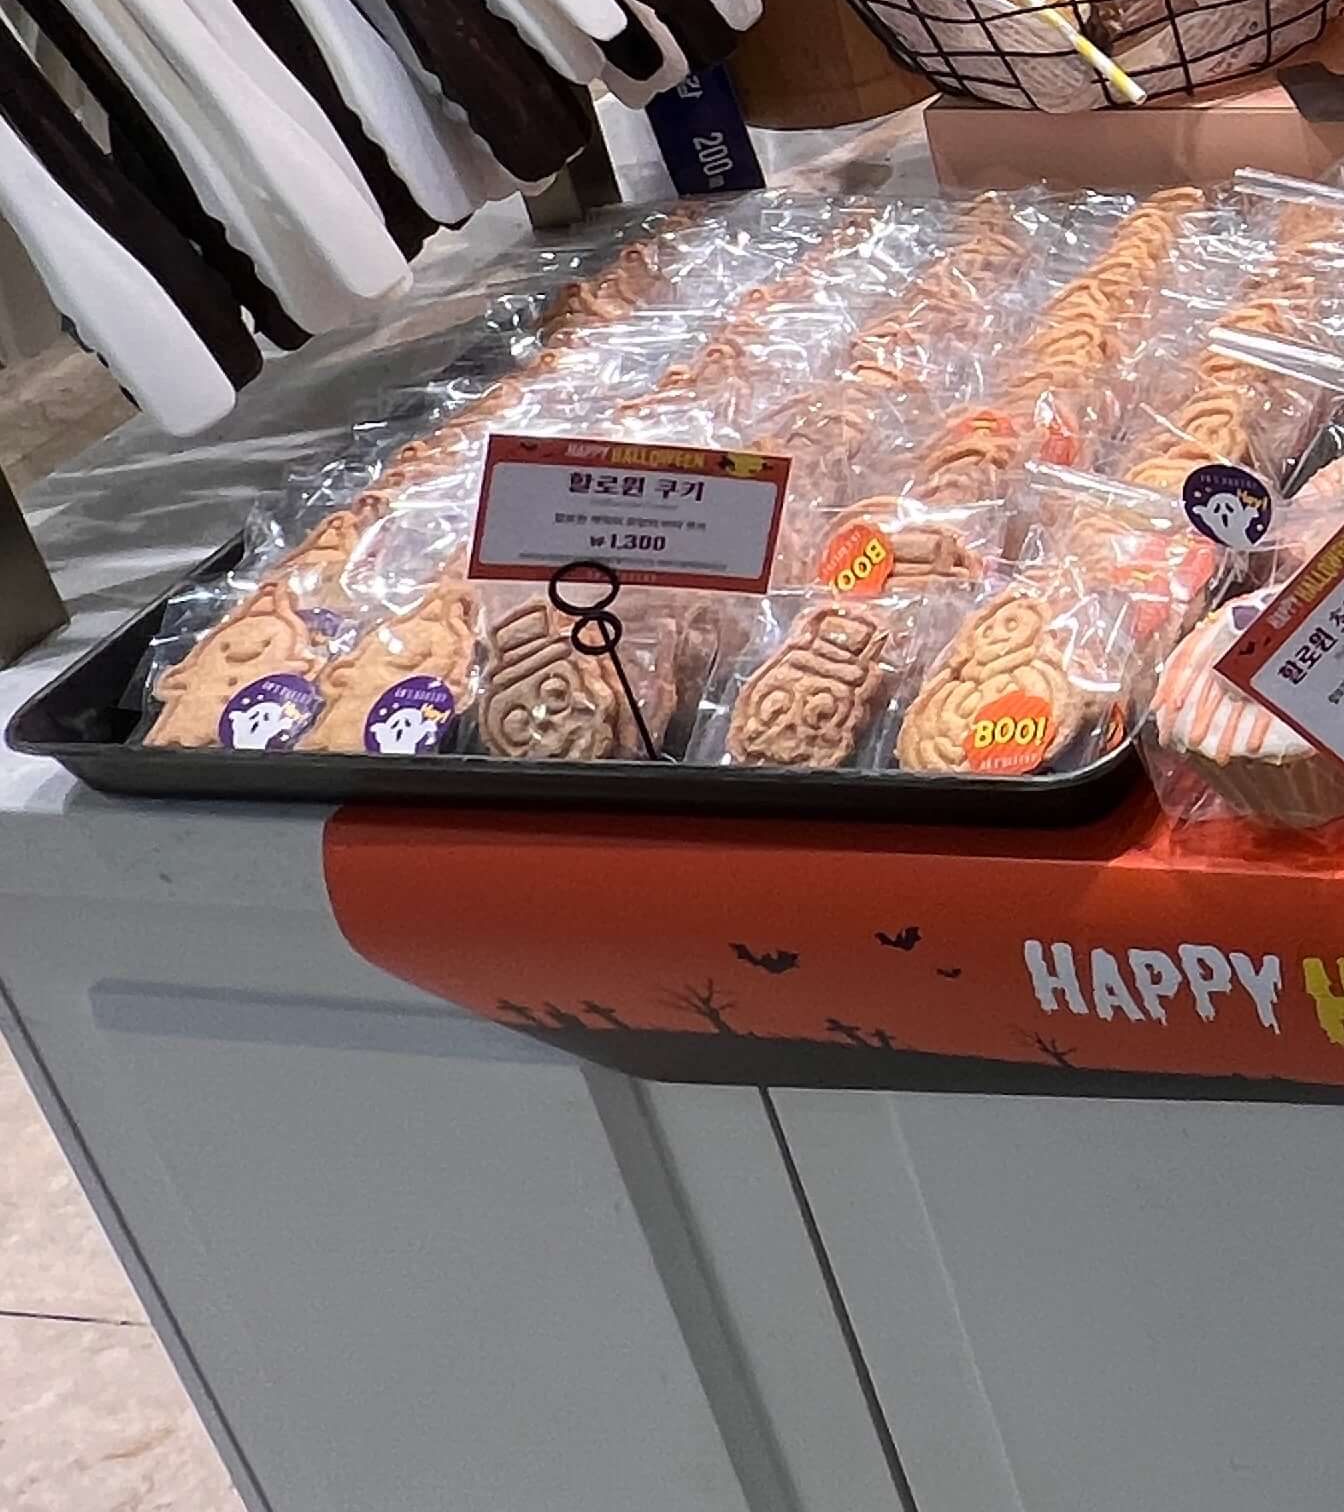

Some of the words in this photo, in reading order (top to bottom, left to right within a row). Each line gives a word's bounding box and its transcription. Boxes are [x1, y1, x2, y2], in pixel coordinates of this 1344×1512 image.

[692, 131, 735, 188] 200
[610, 446, 706, 470] HALLOWEEN
[568, 471, 646, 498] 할로윈
[653, 477, 705, 503] 쿠키
[1277, 627, 1339, 686] 할로윈
[974, 716, 1048, 749] BOO!
[1023, 938, 1283, 1036] HAPPY
